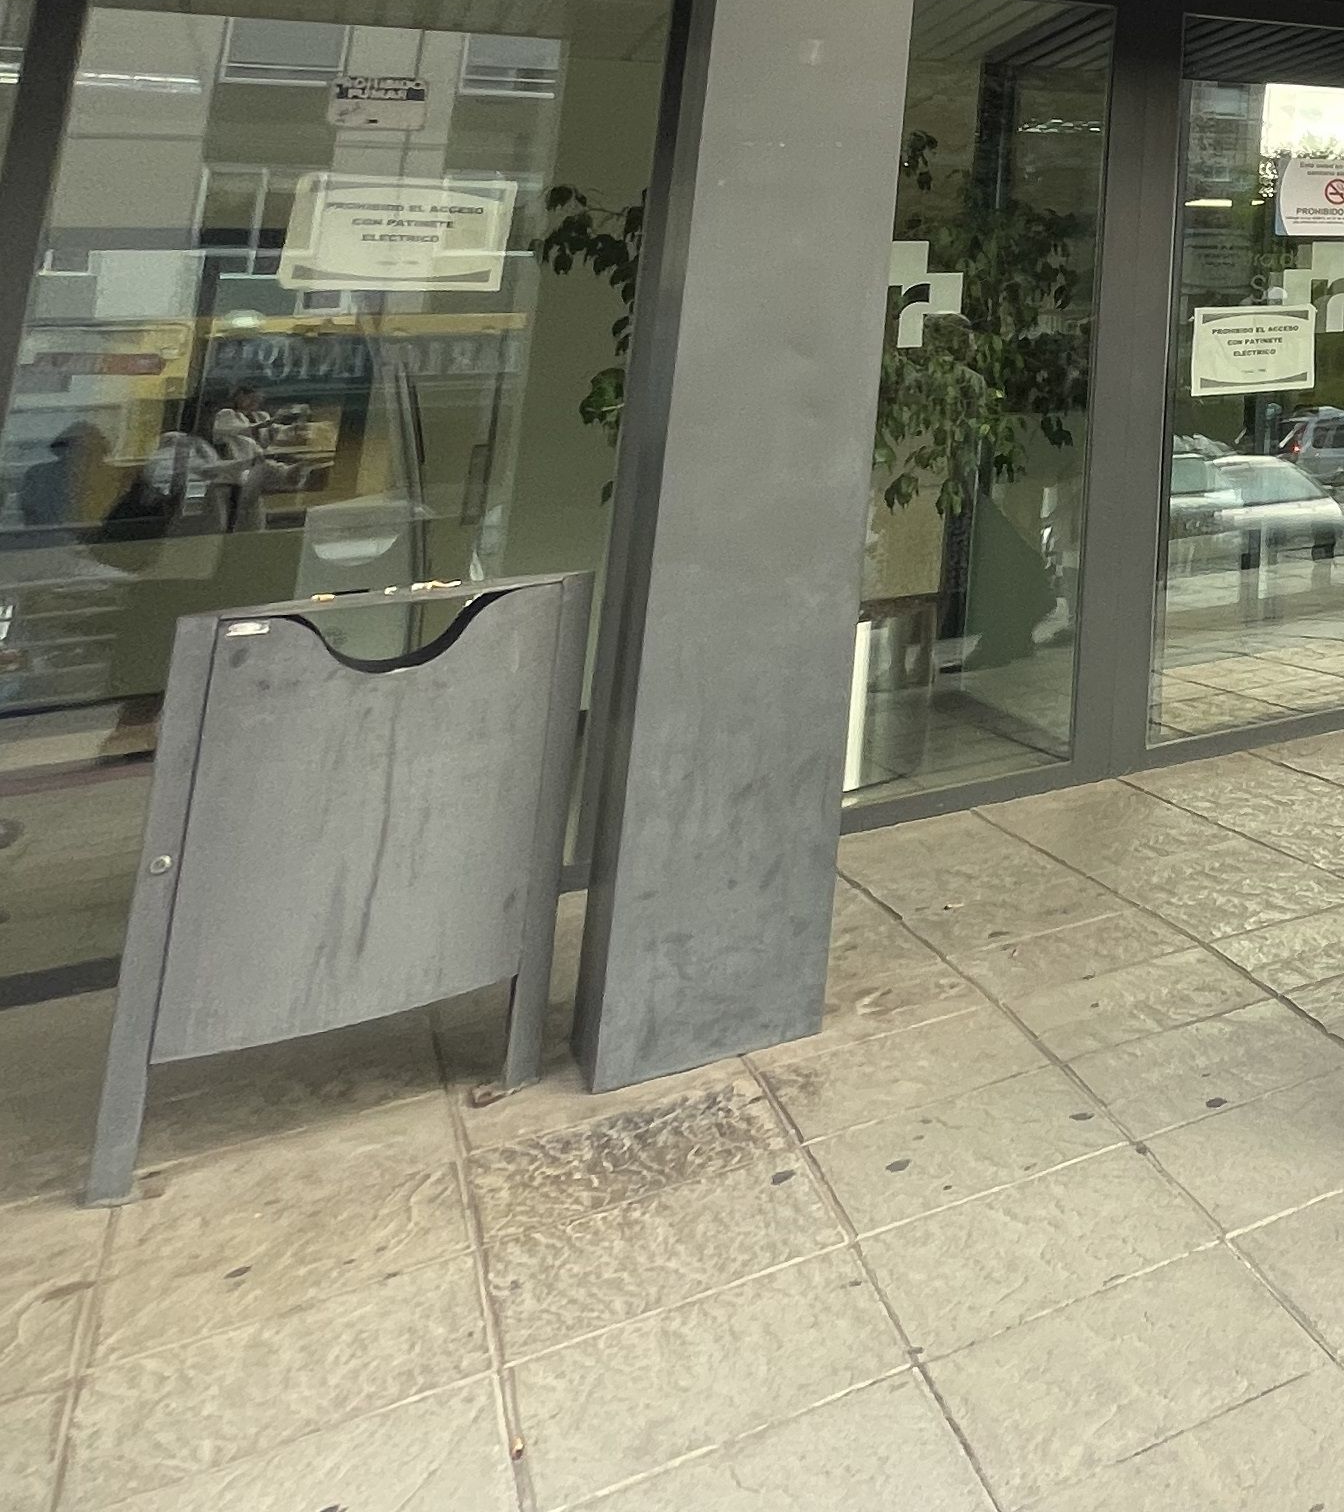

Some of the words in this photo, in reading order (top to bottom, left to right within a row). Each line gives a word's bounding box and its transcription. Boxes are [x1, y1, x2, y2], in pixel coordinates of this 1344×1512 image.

[326, 202, 404, 212] PROHIBIDO
[409, 205, 425, 213] EL
[430, 205, 484, 215] ACCESO
[1296, 207, 1344, 216] PROHIBIDO
[352, 218, 383, 226] CON
[1212, 327, 1254, 335] PROHIBIDO
[1245, 337, 1283, 345] PATINETE
